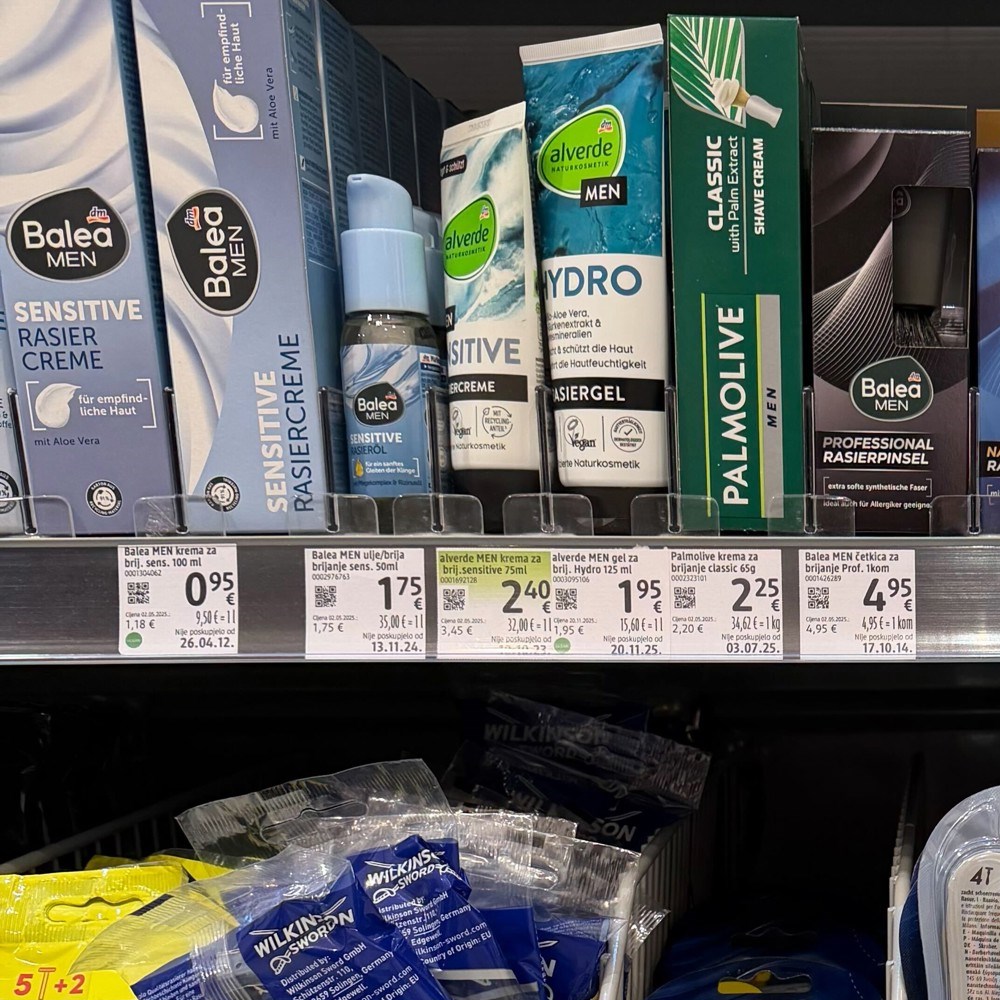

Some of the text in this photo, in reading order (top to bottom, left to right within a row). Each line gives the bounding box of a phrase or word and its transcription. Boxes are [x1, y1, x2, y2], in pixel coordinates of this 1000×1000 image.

[550, 138, 613, 164] alverde
[706, 136, 723, 231] CLASSIC
[753, 138, 764, 234] SHAVE CREAM
[585, 184, 620, 201] MEN
[728, 136, 739, 252] with Palm Extract
[22, 220, 113, 249] Balea
[46, 251, 97, 267] MEN
[200, 207, 231, 297] Balea
[227, 226, 247, 277] MEN
[14, 300, 142, 322] SENSITIVE
[18, 327, 97, 347] RASIER
[22, 351, 103, 370] CREME
[861, 377, 921, 399] Balea
[358, 398, 397, 411] Balea
[719, 306, 749, 505] PALMOLIVE
[766, 386, 777, 428] MEN
[875, 397, 908, 411] MEN
[278, 333, 315, 512] RASIERCREME
[366, 412, 389, 420] MEN
[254, 370, 289, 513] SENSITIVE
[350, 432, 402, 444] SENSITIVE
[823, 436, 934, 450] PROFESSIONAL
[823, 451, 929, 465] RASIERPINSEL
[124, 547, 150, 556] Balea
[152, 547, 172, 556] MEN
[176, 547, 204, 555] krema
[312, 550, 404, 562] Balea MEN ulje/brija
[440, 554, 475, 563] alverde
[477, 554, 497, 563] MEN
[501, 554, 528, 563] krema
[552, 553, 586, 562] alverde
[588, 554, 609, 562] MEN
[612, 554, 626, 564] gel
[671, 551, 758, 561] Palmolive krema za
[805, 551, 899, 561] Balea MEN četkica za
[671, 563, 756, 574] brijanje classic 65g
[226, 593, 234, 606] €
[180, 638, 234, 648] 26.04.12.
[372, 642, 422, 652] 13.11.24.
[727, 643, 780, 653] 03.07.25.
[863, 643, 912, 653] 17.10.14.
[281, 956, 331, 987] Distributed by:
[14, 974, 33, 996] 5
[410, 974, 419, 986] EU
